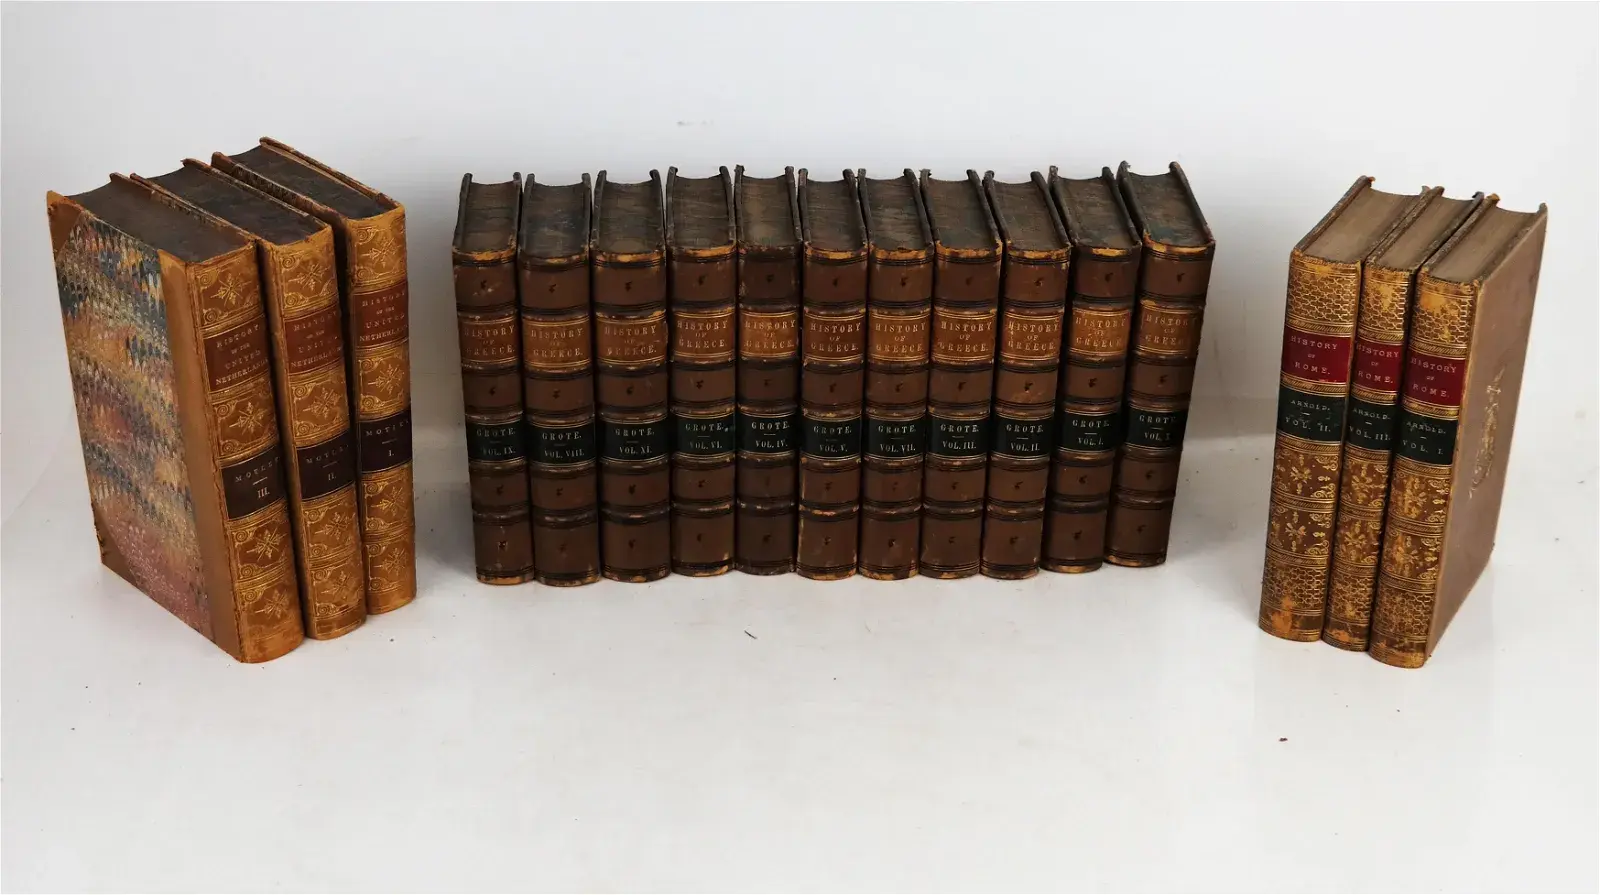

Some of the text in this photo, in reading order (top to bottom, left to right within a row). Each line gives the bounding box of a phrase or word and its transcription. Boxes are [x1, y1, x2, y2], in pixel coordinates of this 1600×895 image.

[677, 320, 727, 331] HISTORY
[745, 320, 795, 330] HISTORY
[875, 323, 926, 333] HISTORY
[941, 321, 991, 332] HISTORY
[1008, 321, 1059, 333] HISTORY
[1075, 317, 1126, 328] HISTORY
[464, 325, 515, 337] HISTORY
[604, 325, 656, 336] HISTORY
[810, 323, 861, 334] HISTORY
[216, 324, 260, 348] HISTORY
[531, 328, 583, 341] HISTORY
[1291, 335, 1338, 350] HISTORY
[1356, 343, 1399, 358] HISTORY
[225, 350, 261, 369] UNITED
[1295, 362, 1331, 375] ROME.
[1411, 358, 1457, 373] HISTORY
[1358, 371, 1393, 384] ROME.
[1413, 383, 1450, 398] ROME.
[1285, 416, 1331, 432] VOL. II.
[542, 431, 582, 441] GROTE.
[615, 427, 655, 436] GROTE.
[1349, 426, 1391, 441] VOL. III.
[711, 441, 723, 449] VI.
[755, 439, 788, 448] VOL. IV.
[819, 444, 848, 453] VOL. V.
[879, 443, 898, 453] VOL.
[942, 440, 977, 449] VOL. III.
[1010, 442, 1029, 451] VOL.
[1402, 439, 1428, 453] VOL.
[544, 449, 563, 458] VOL.
[328, 472, 336, 481] II.
[257, 487, 270, 499] III.
